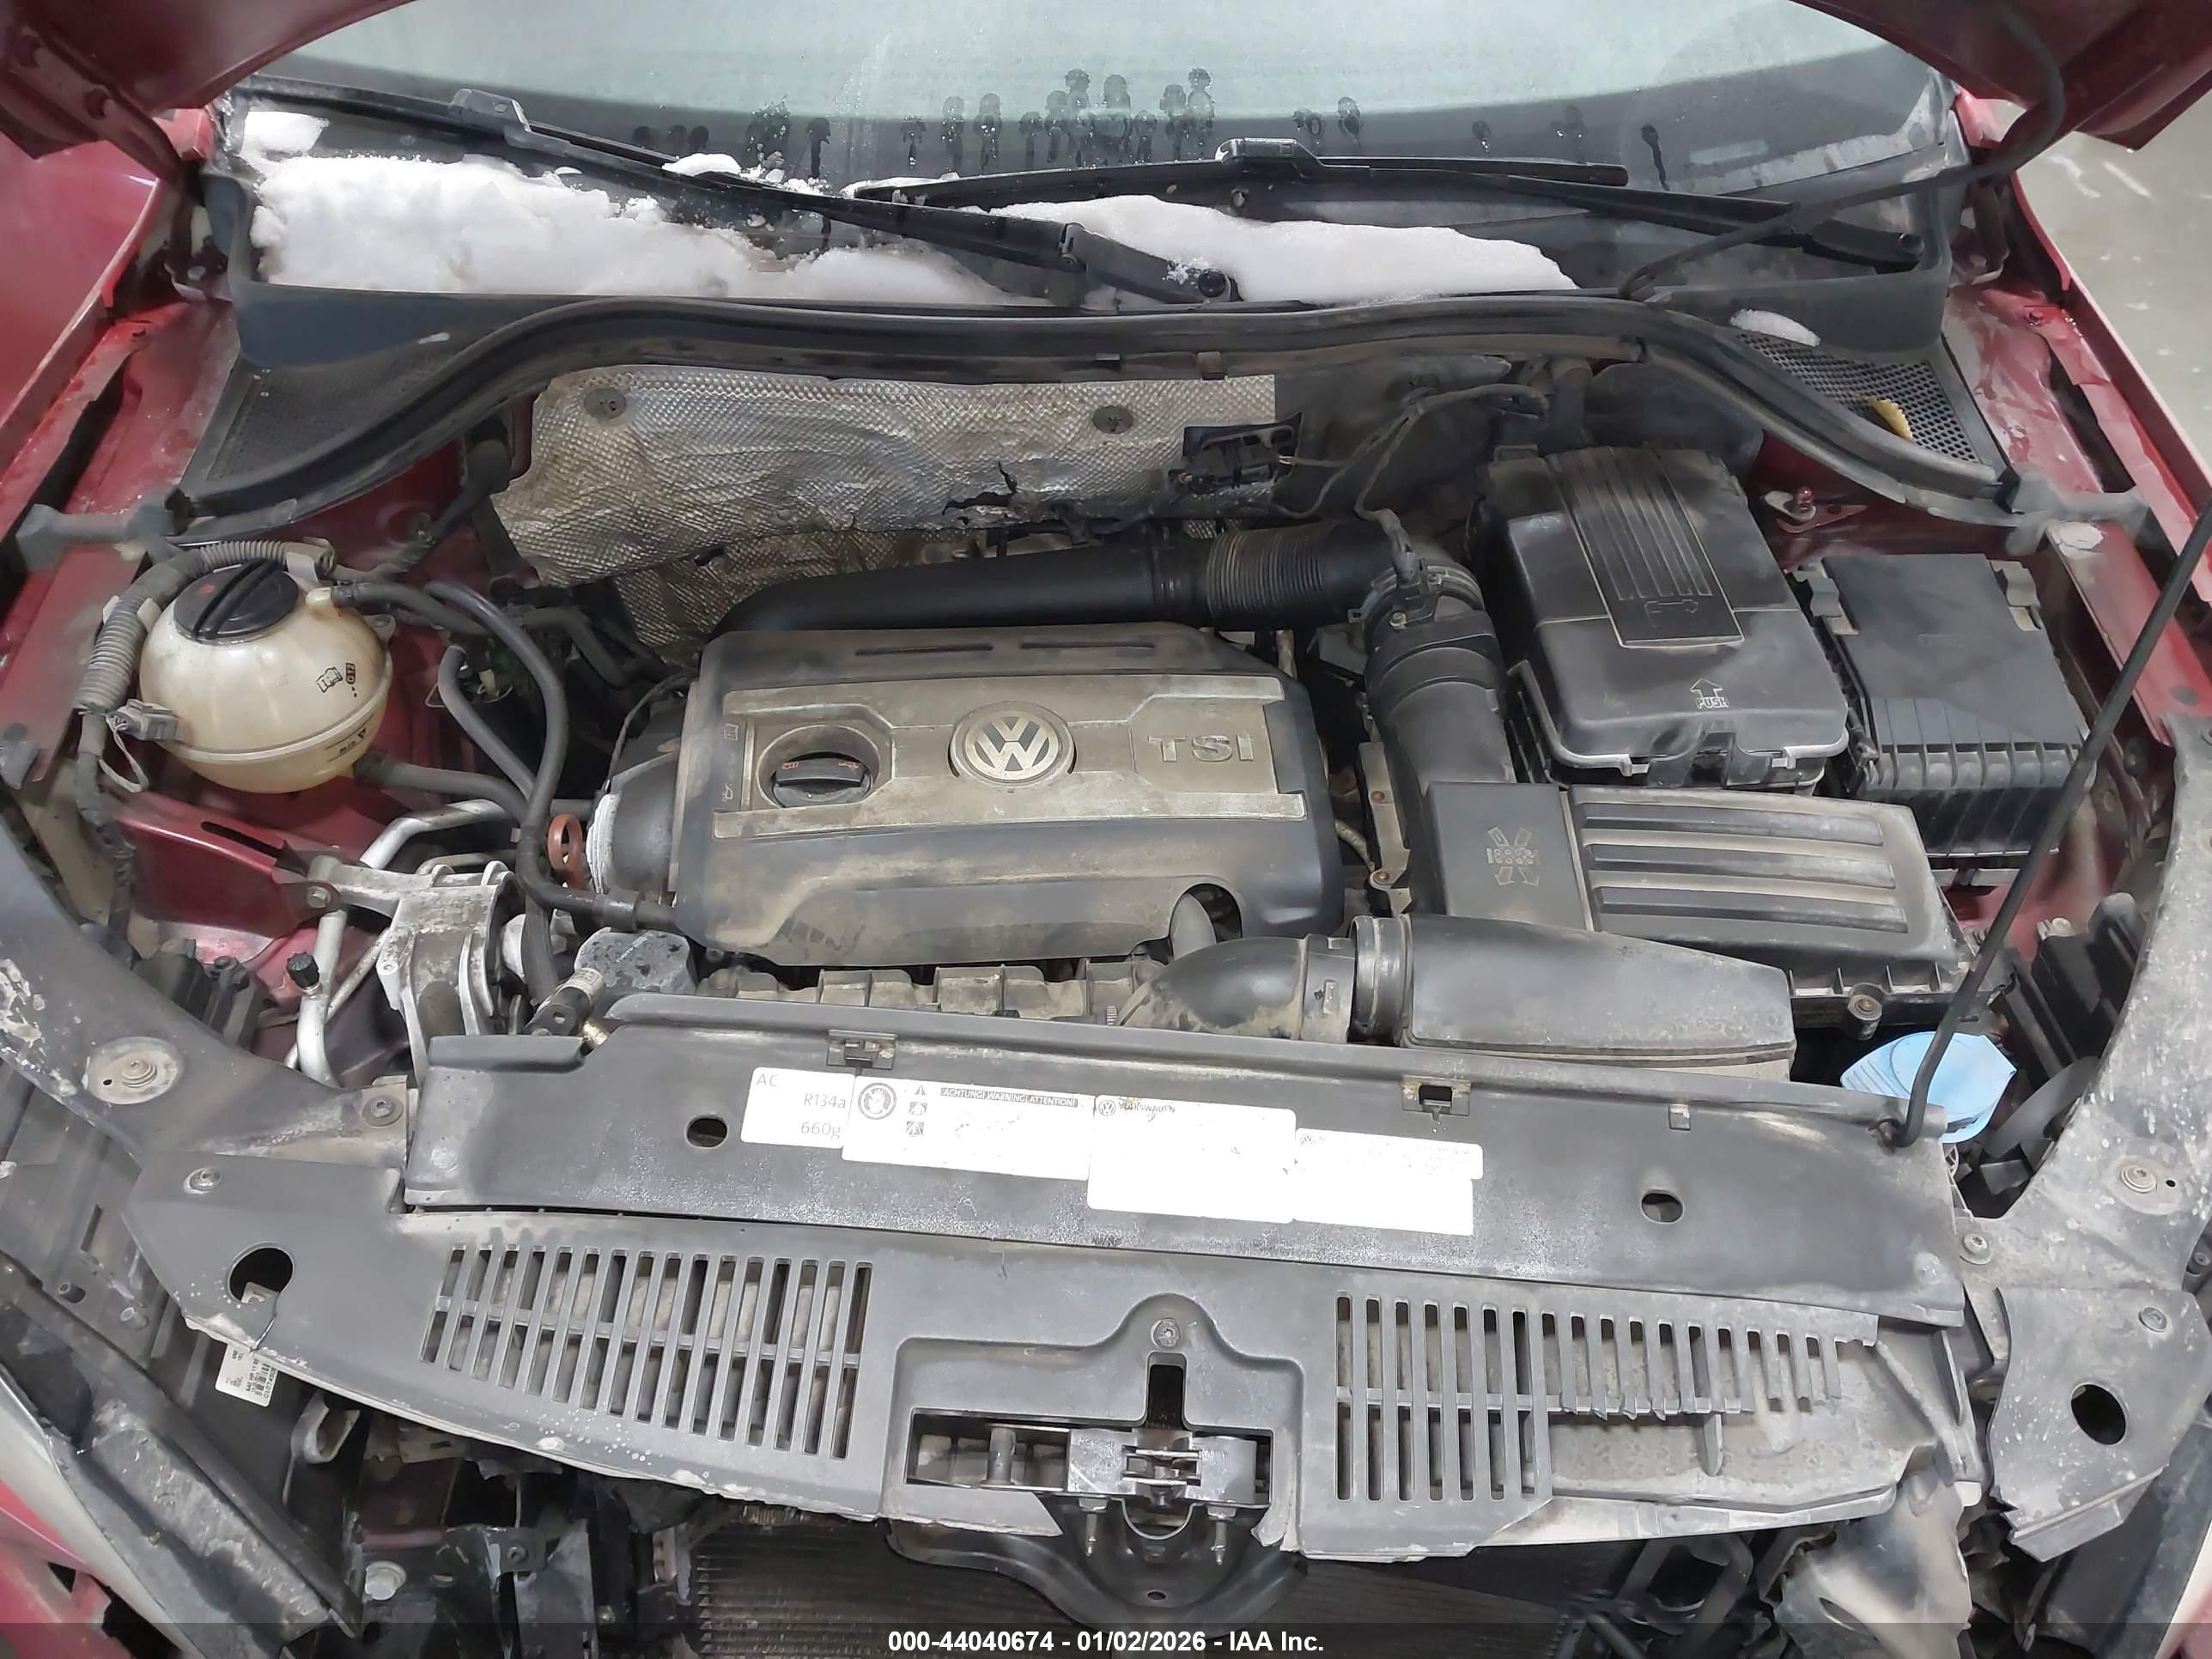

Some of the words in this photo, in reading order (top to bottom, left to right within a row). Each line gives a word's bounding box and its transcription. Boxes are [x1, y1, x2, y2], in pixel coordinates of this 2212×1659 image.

[1697, 696, 1730, 708] PUSH
[1148, 734, 1255, 763] TSI
[756, 1073, 779, 1087] AC
[804, 1092, 846, 1109] R134a
[800, 1121, 841, 1140] 660g
